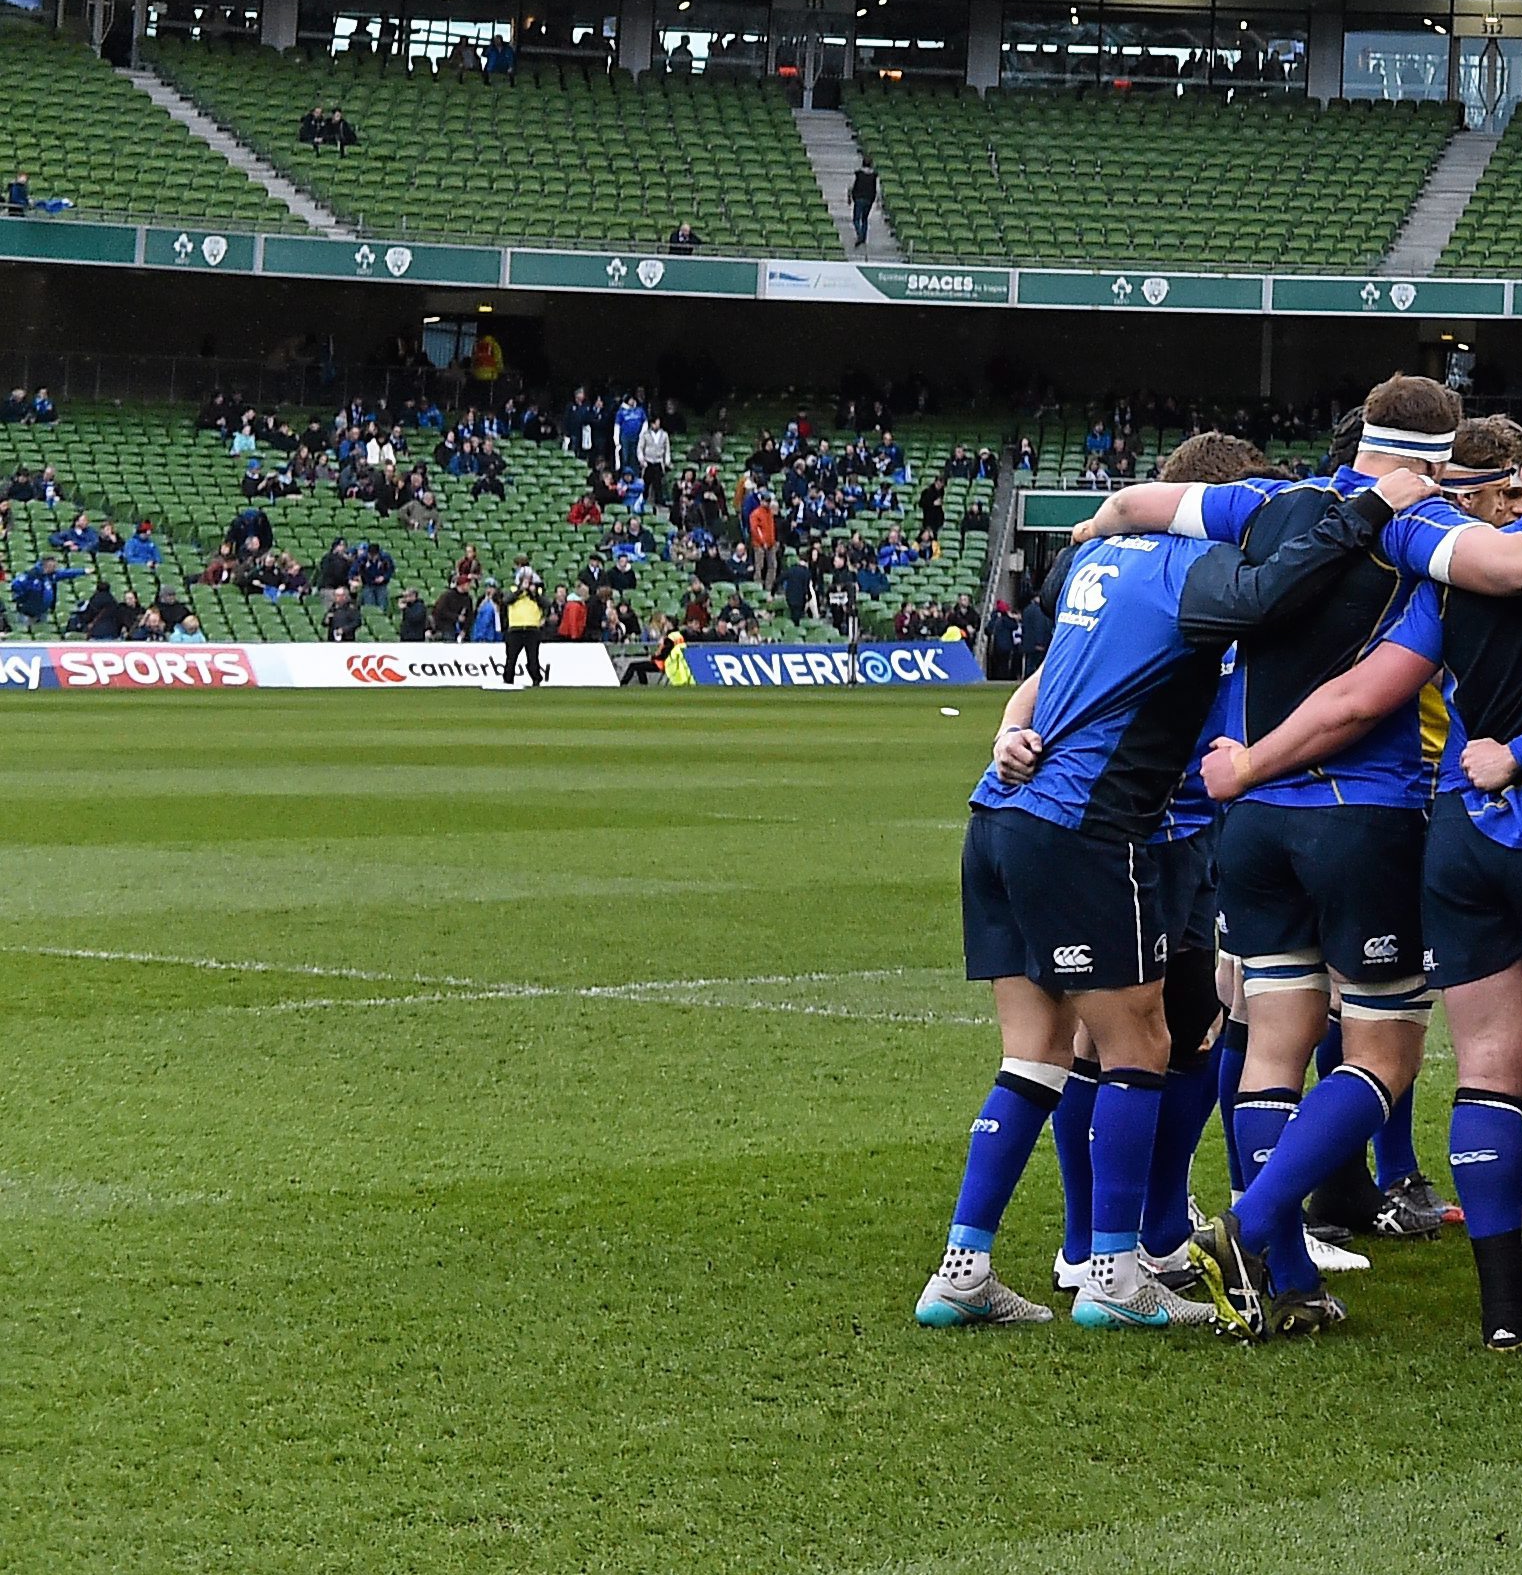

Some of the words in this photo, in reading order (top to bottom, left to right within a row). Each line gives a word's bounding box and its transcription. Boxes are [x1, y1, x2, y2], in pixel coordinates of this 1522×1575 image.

[1481, 24, 1504, 35] 312
[907, 274, 973, 292] SPACES
[0, 655, 41, 690] ky
[60, 652, 249, 686] SPORTS
[714, 649, 949, 686] RIVERROCK
